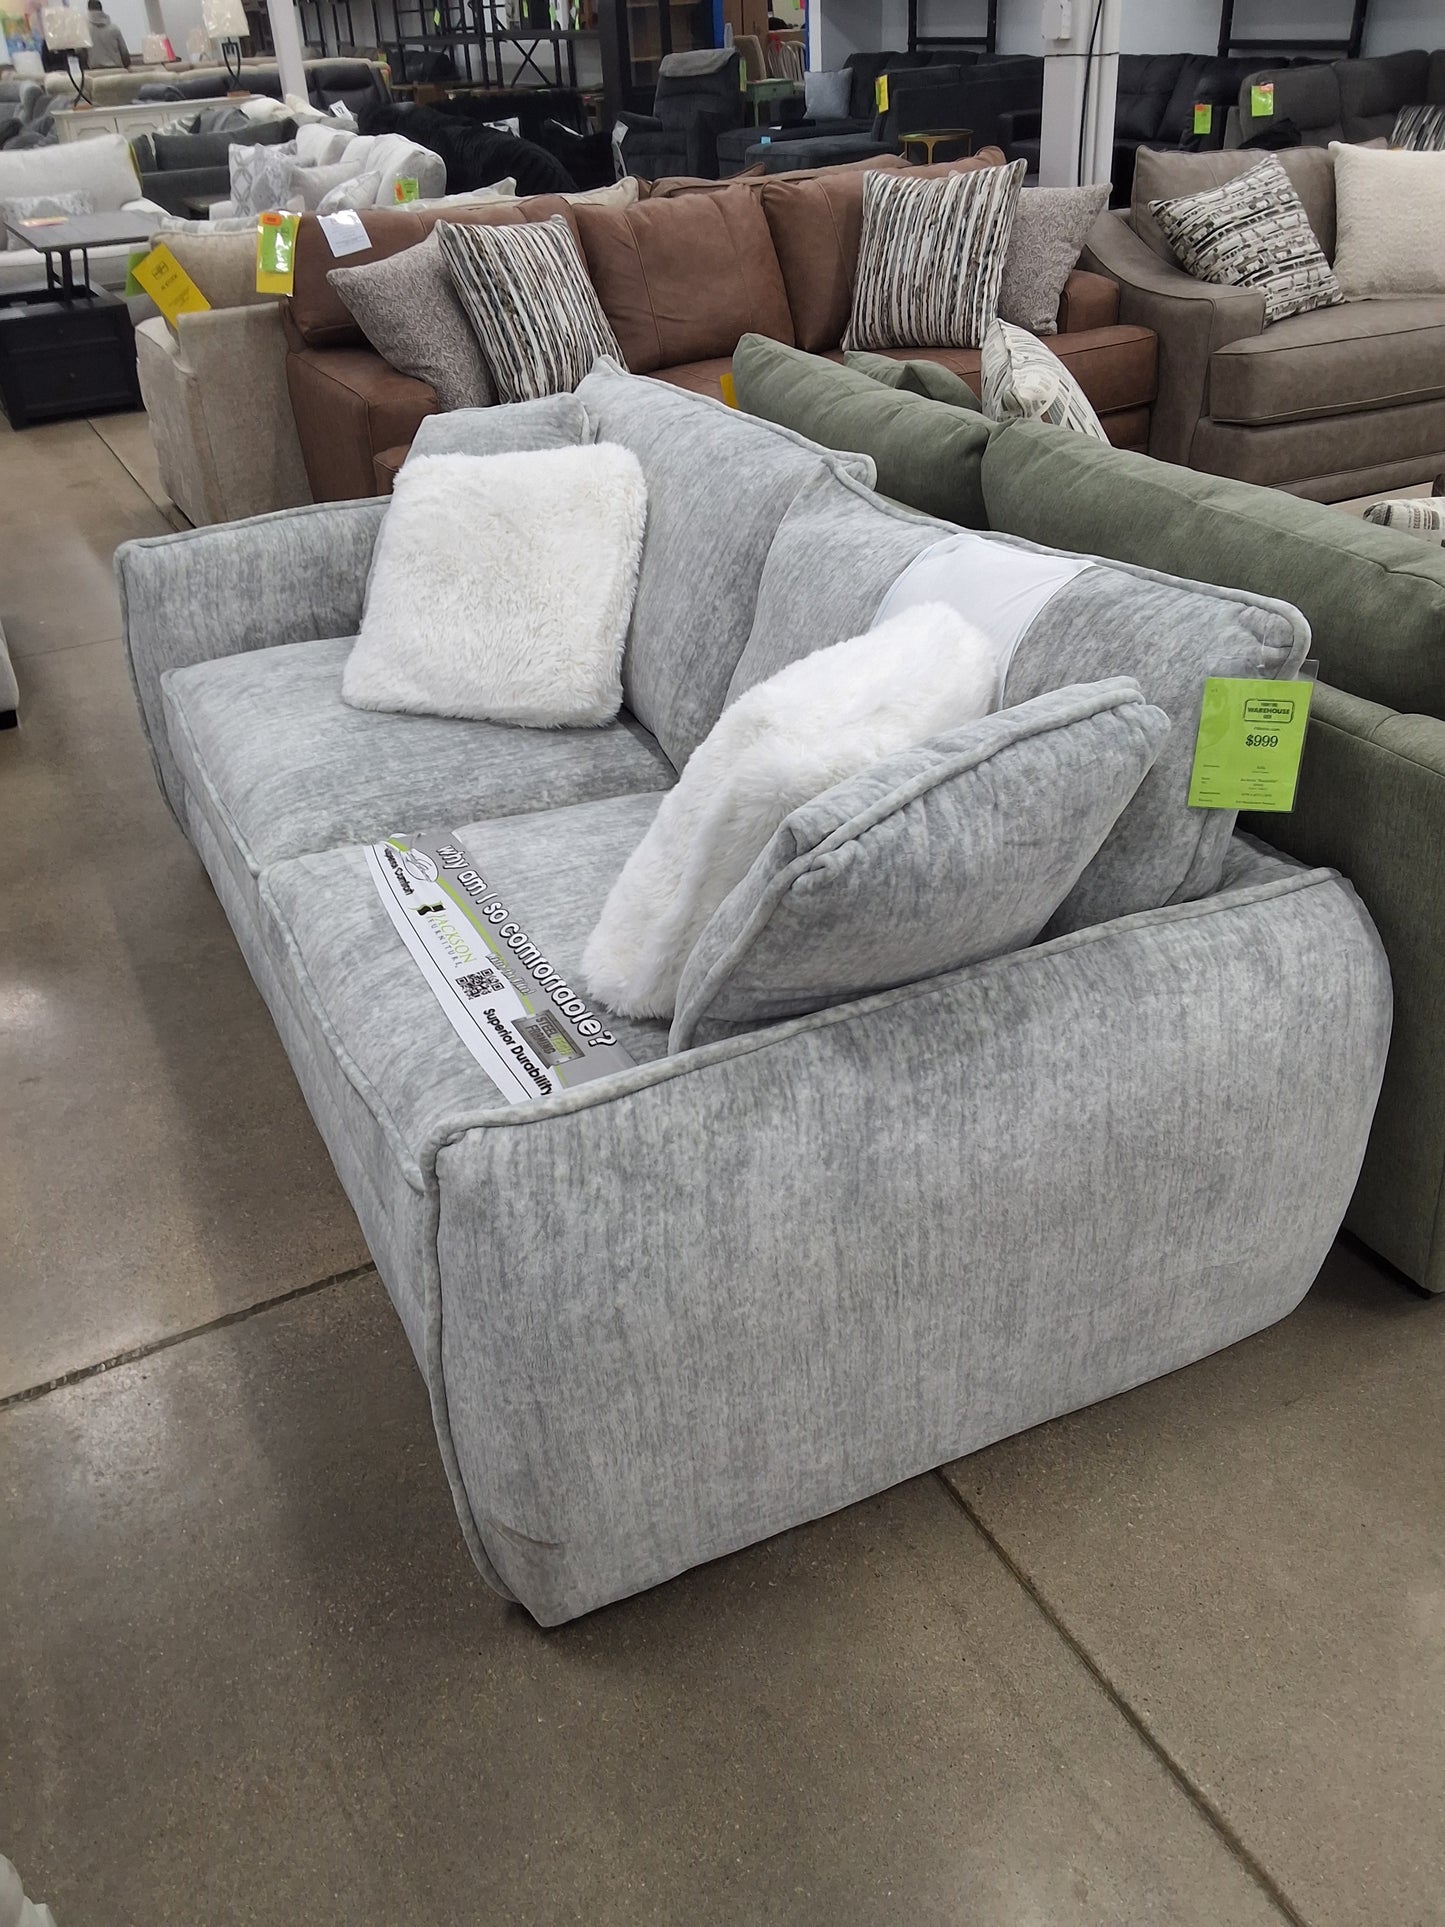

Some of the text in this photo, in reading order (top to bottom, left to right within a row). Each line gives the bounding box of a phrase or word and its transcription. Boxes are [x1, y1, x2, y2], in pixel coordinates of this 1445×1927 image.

[1247, 707, 1290, 715] WAREHOUSE
[1245, 734, 1279, 747] $999
[436, 845, 469, 870] why
[457, 869, 487, 896] am
[483, 901, 509, 924] so
[428, 916, 475, 963] JACKSON
[536, 1015, 556, 1036] STEEL
[483, 1007, 515, 1046] Superior
[510, 1045, 552, 1096] Durability
